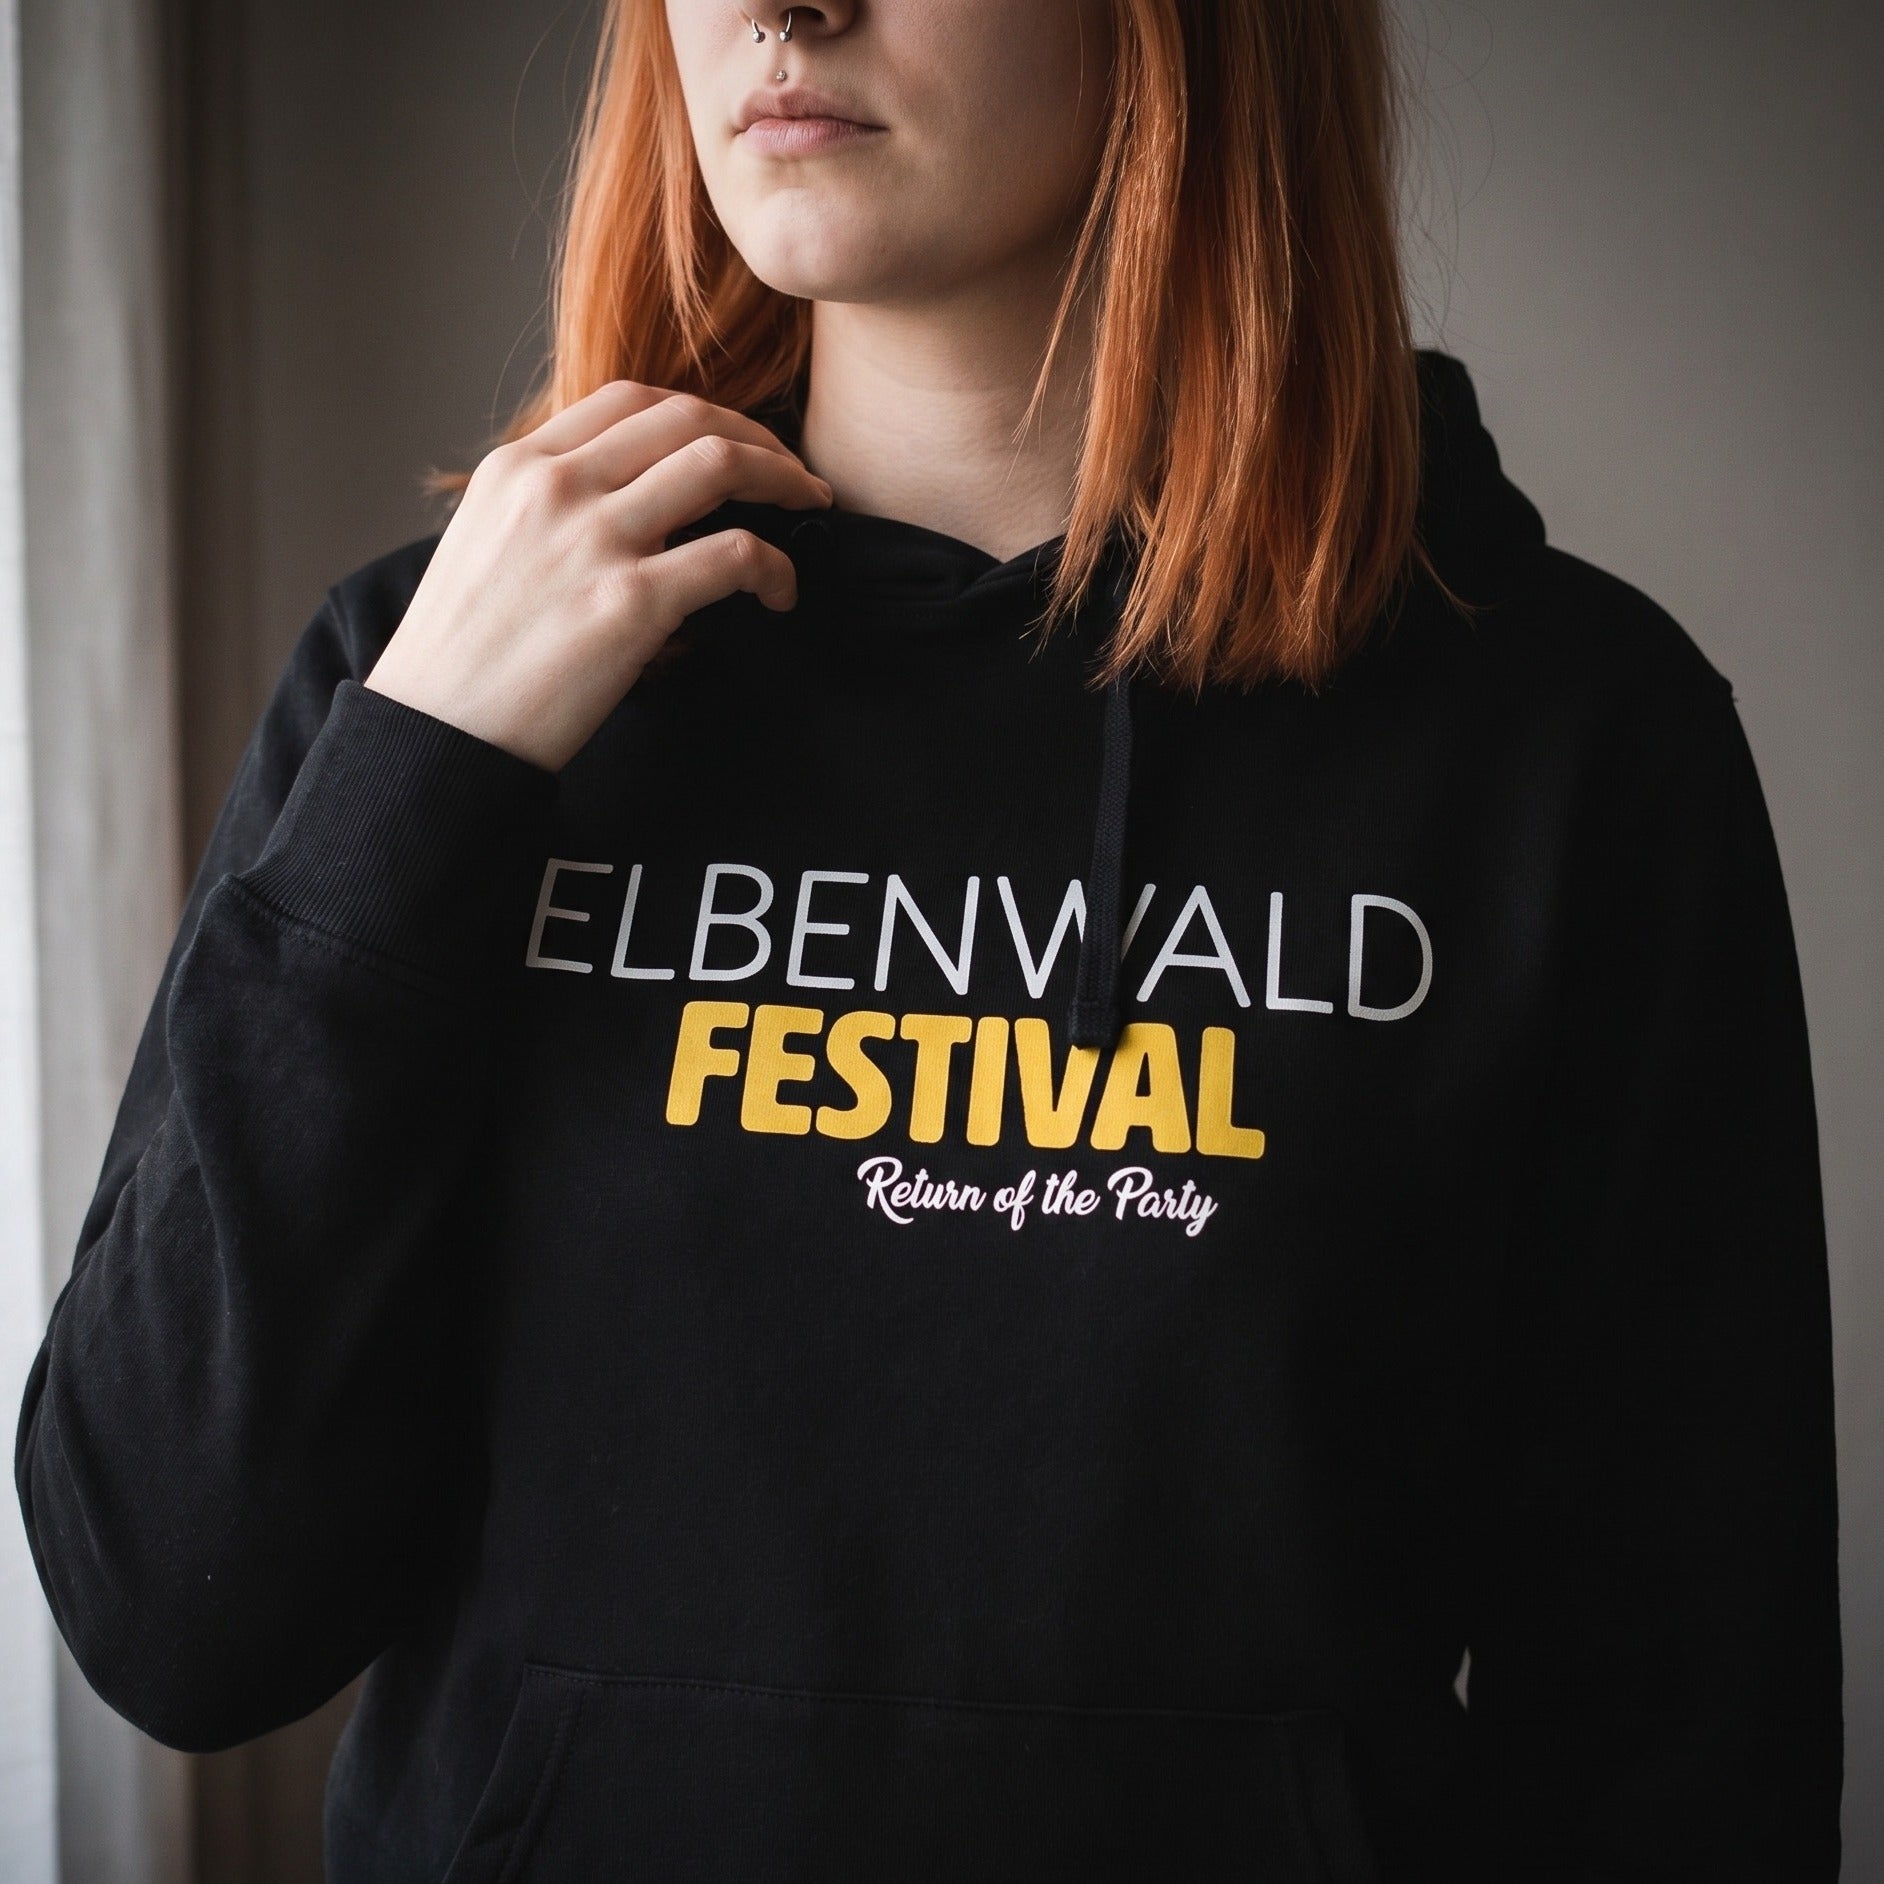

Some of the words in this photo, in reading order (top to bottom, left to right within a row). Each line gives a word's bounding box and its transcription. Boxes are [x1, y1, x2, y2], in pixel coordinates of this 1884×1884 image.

[525, 857, 1435, 1022] ELBENWALD
[665, 1000, 1266, 1160] FESTIVAL
[856, 1155, 988, 1226] Return
[992, 1169, 1037, 1232] of
[1041, 1169, 1101, 1216] the
[1106, 1165, 1219, 1239] Party
